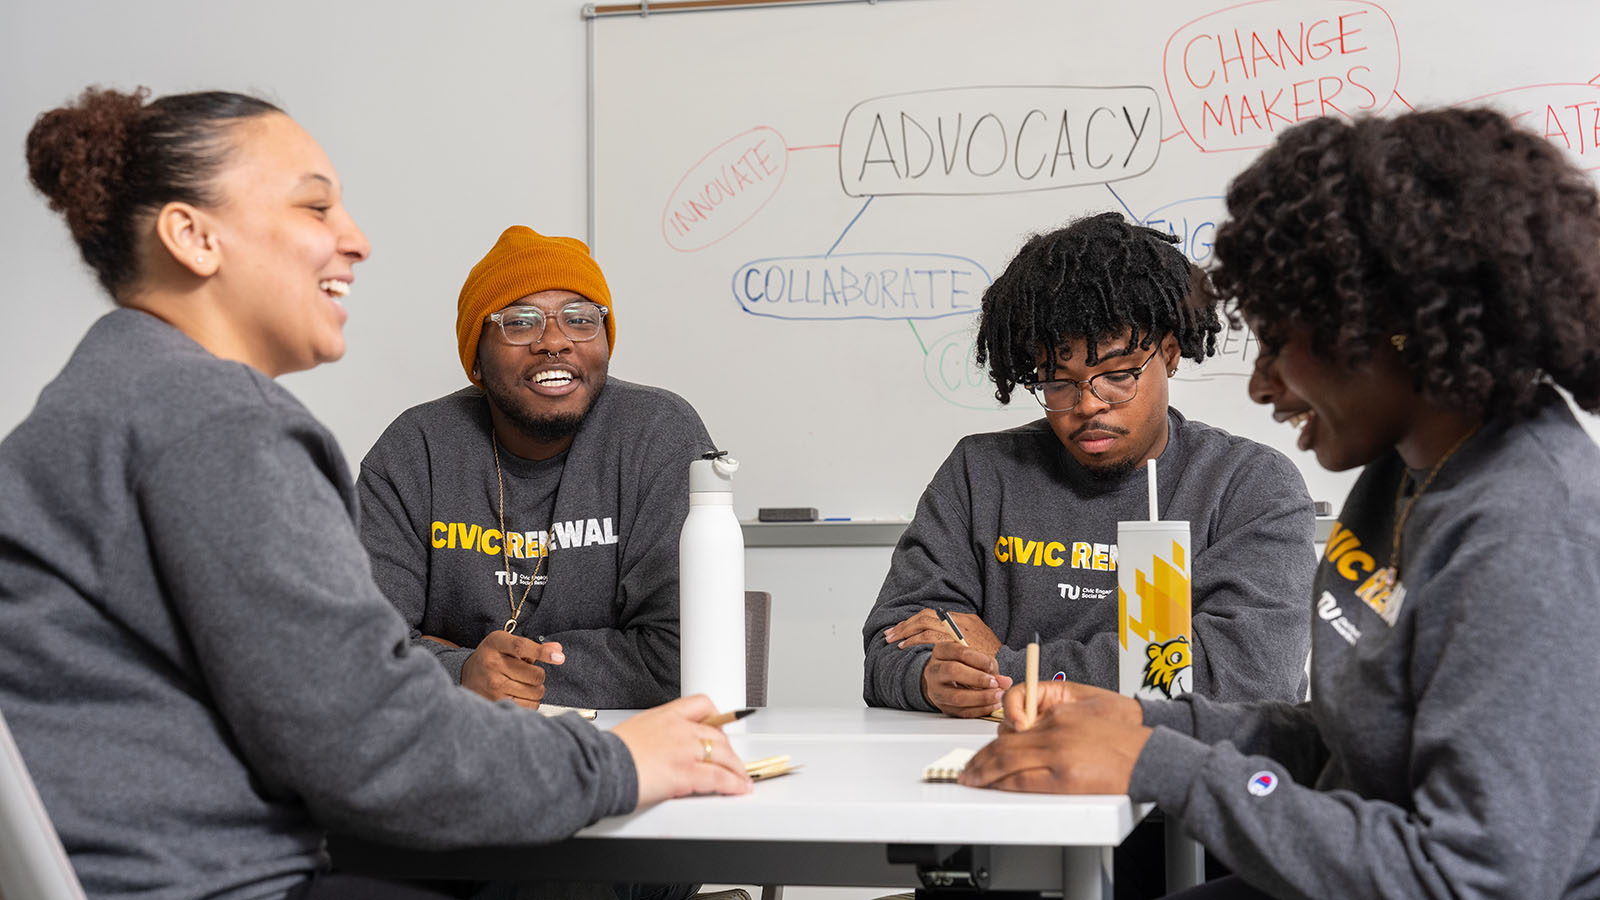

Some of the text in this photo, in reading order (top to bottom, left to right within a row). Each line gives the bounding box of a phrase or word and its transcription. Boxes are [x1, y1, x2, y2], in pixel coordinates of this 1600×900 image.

[1184, 10, 1368, 89] CHANGE
[1203, 65, 1376, 139] MAKERS
[859, 106, 1150, 181] ADVOCACY
[669, 139, 779, 237] INNOVATE
[1147, 217, 1219, 262] NG
[744, 265, 973, 309] COLLABORATE
[431, 521, 502, 556] CIVIC
[995, 536, 1066, 567] CIVIC
[494, 570, 518, 586] TU
[1057, 582, 1080, 600] TU
